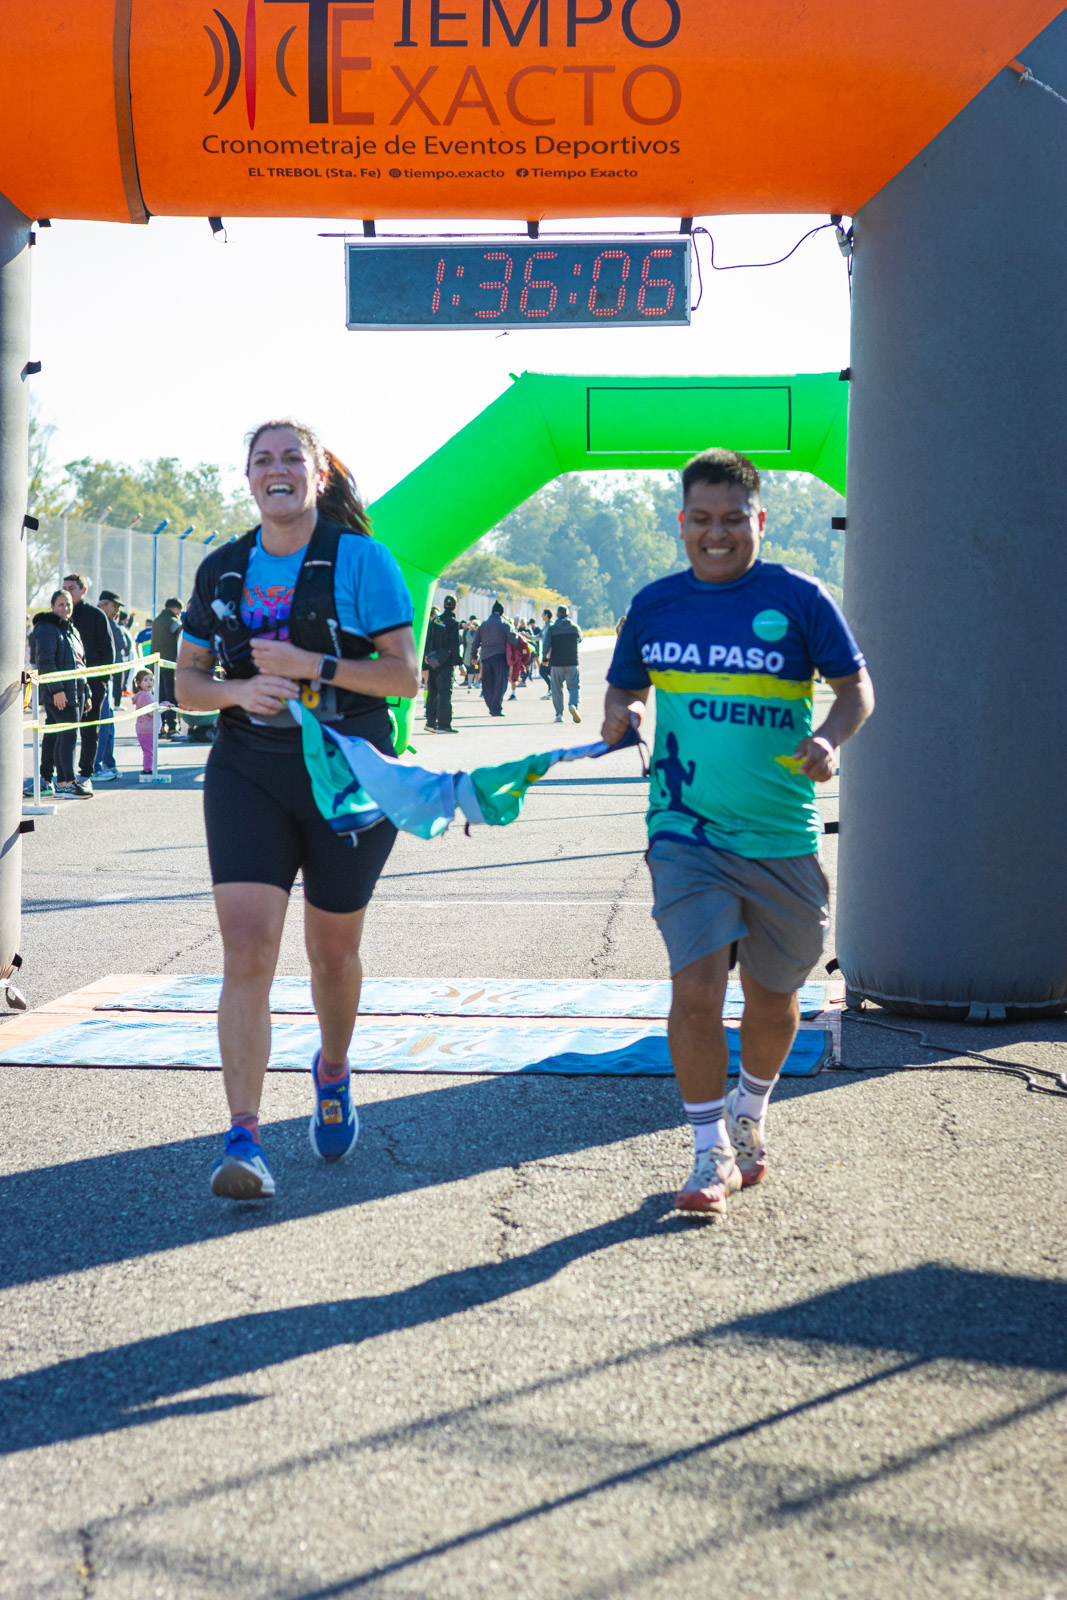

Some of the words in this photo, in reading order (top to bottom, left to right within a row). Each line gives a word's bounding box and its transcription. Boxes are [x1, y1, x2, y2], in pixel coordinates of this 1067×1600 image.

[202, 134, 376, 159] Cronometraje
[384, 134, 416, 155] de
[424, 136, 527, 155] Eventos
[535, 135, 680, 159] Deportivos
[248, 167, 264, 177] EL
[267, 167, 322, 178] TREBOL
[325, 167, 357, 179] (Sta.
[360, 167, 381, 179] Fe)
[404, 168, 505, 180] tiempo.exacto
[531, 168, 587, 179] Tiempo
[590, 168, 638, 178] Exacto
[708, 644, 785, 673] PASO
[688, 698, 795, 730] CUENTA
